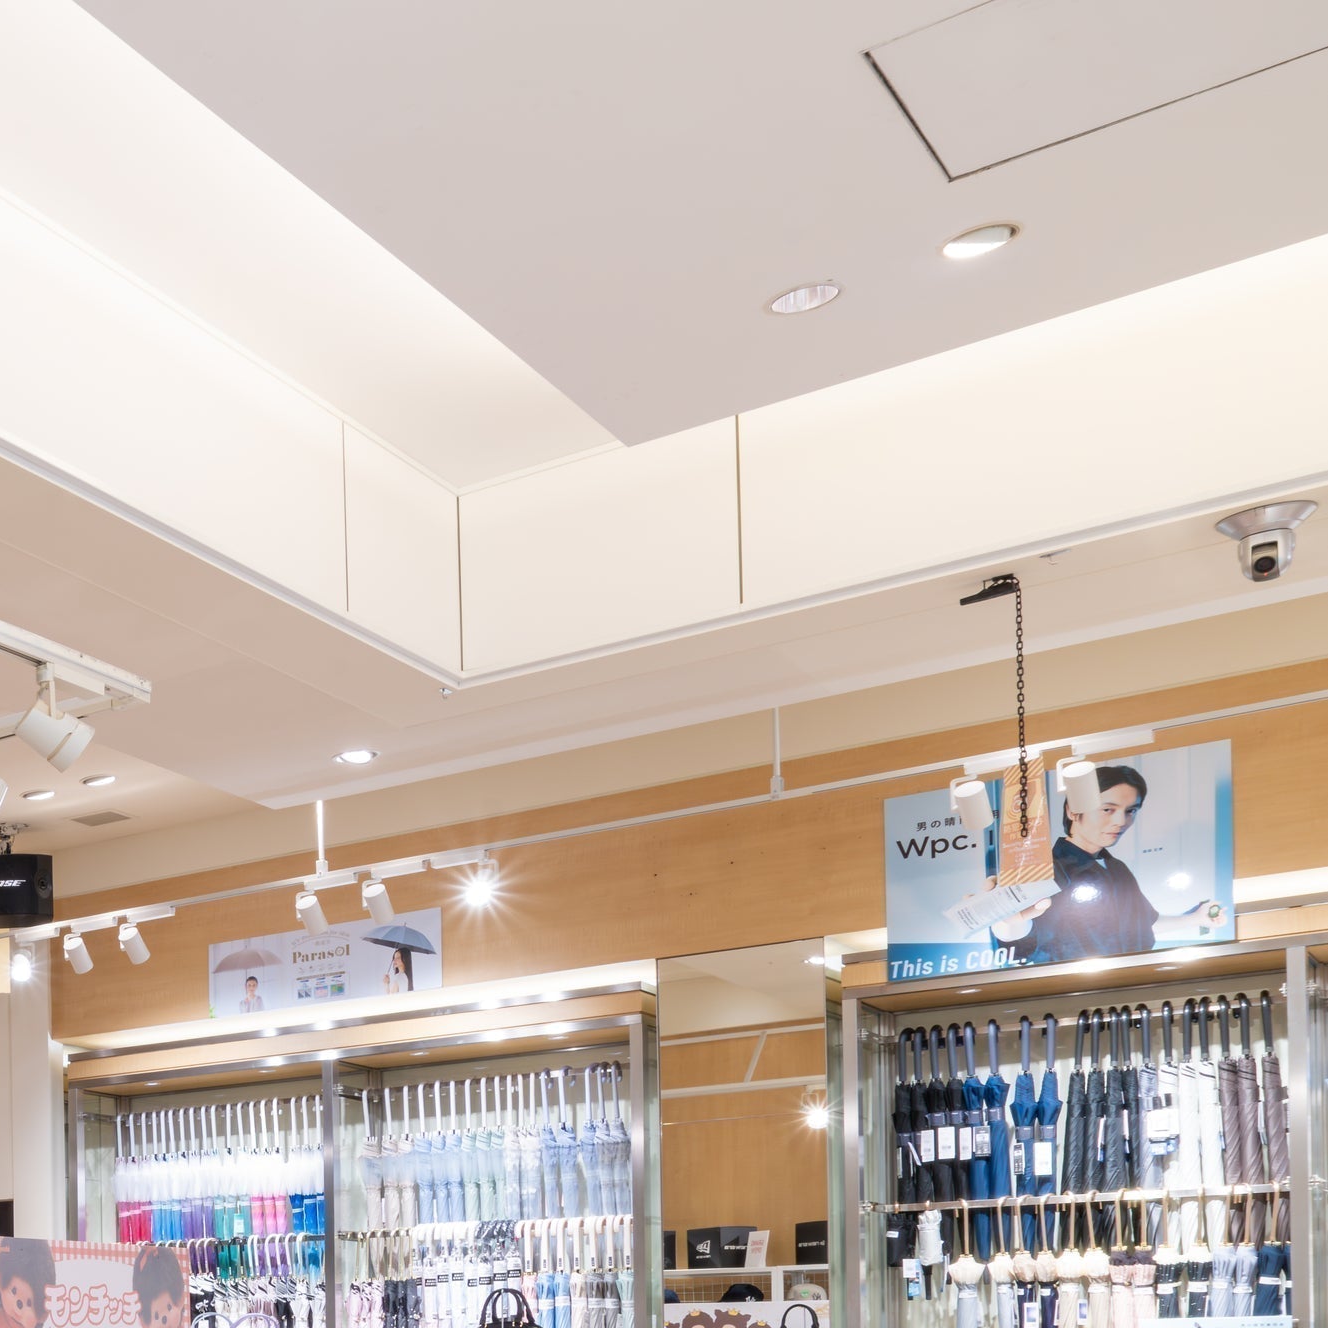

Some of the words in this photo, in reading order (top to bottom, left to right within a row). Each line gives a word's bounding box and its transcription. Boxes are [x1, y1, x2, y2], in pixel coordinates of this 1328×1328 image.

[896, 835, 977, 859] Wpc.
[292, 944, 350, 964] Parasol
[890, 958, 933, 979] This
[940, 955, 959, 973] is
[966, 946, 1027, 970] COOL.
[44, 1284, 142, 1328] モンチッチ
